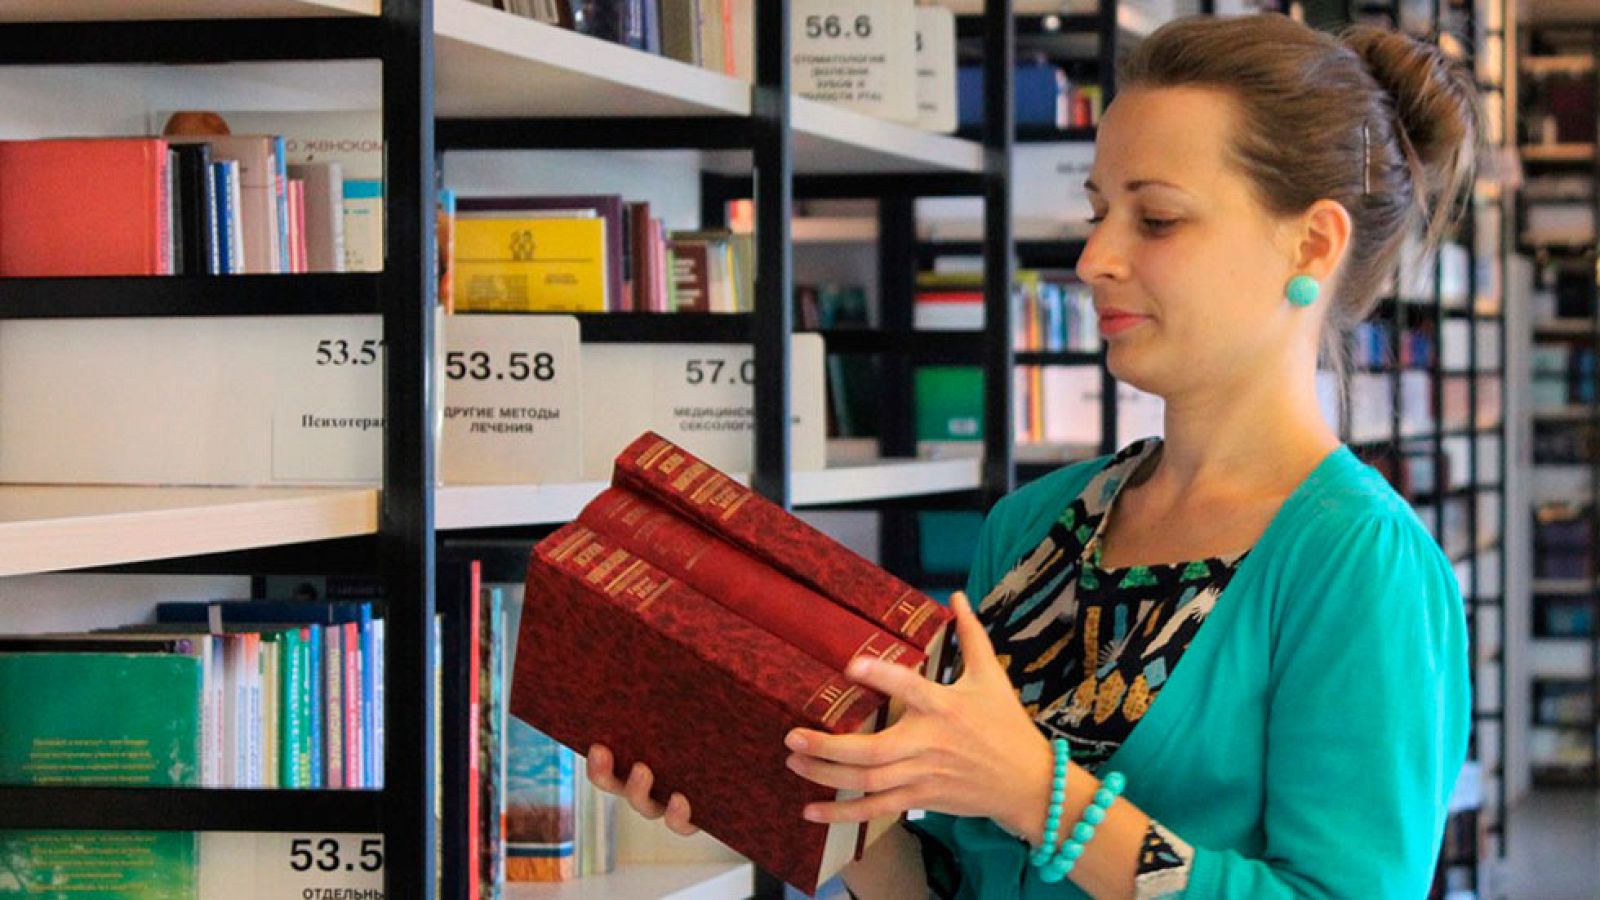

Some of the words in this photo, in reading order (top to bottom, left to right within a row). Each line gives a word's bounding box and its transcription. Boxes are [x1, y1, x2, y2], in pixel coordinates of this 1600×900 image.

[806, 15, 870, 37] 56.6
[315, 339, 384, 366] 53.5
[445, 351, 556, 381] 53.58
[444, 407, 495, 420] ДРУГИЕ
[499, 407, 561, 420] МЕТОДЫ
[470, 422, 534, 434] ЛЕЧЕНИЯ
